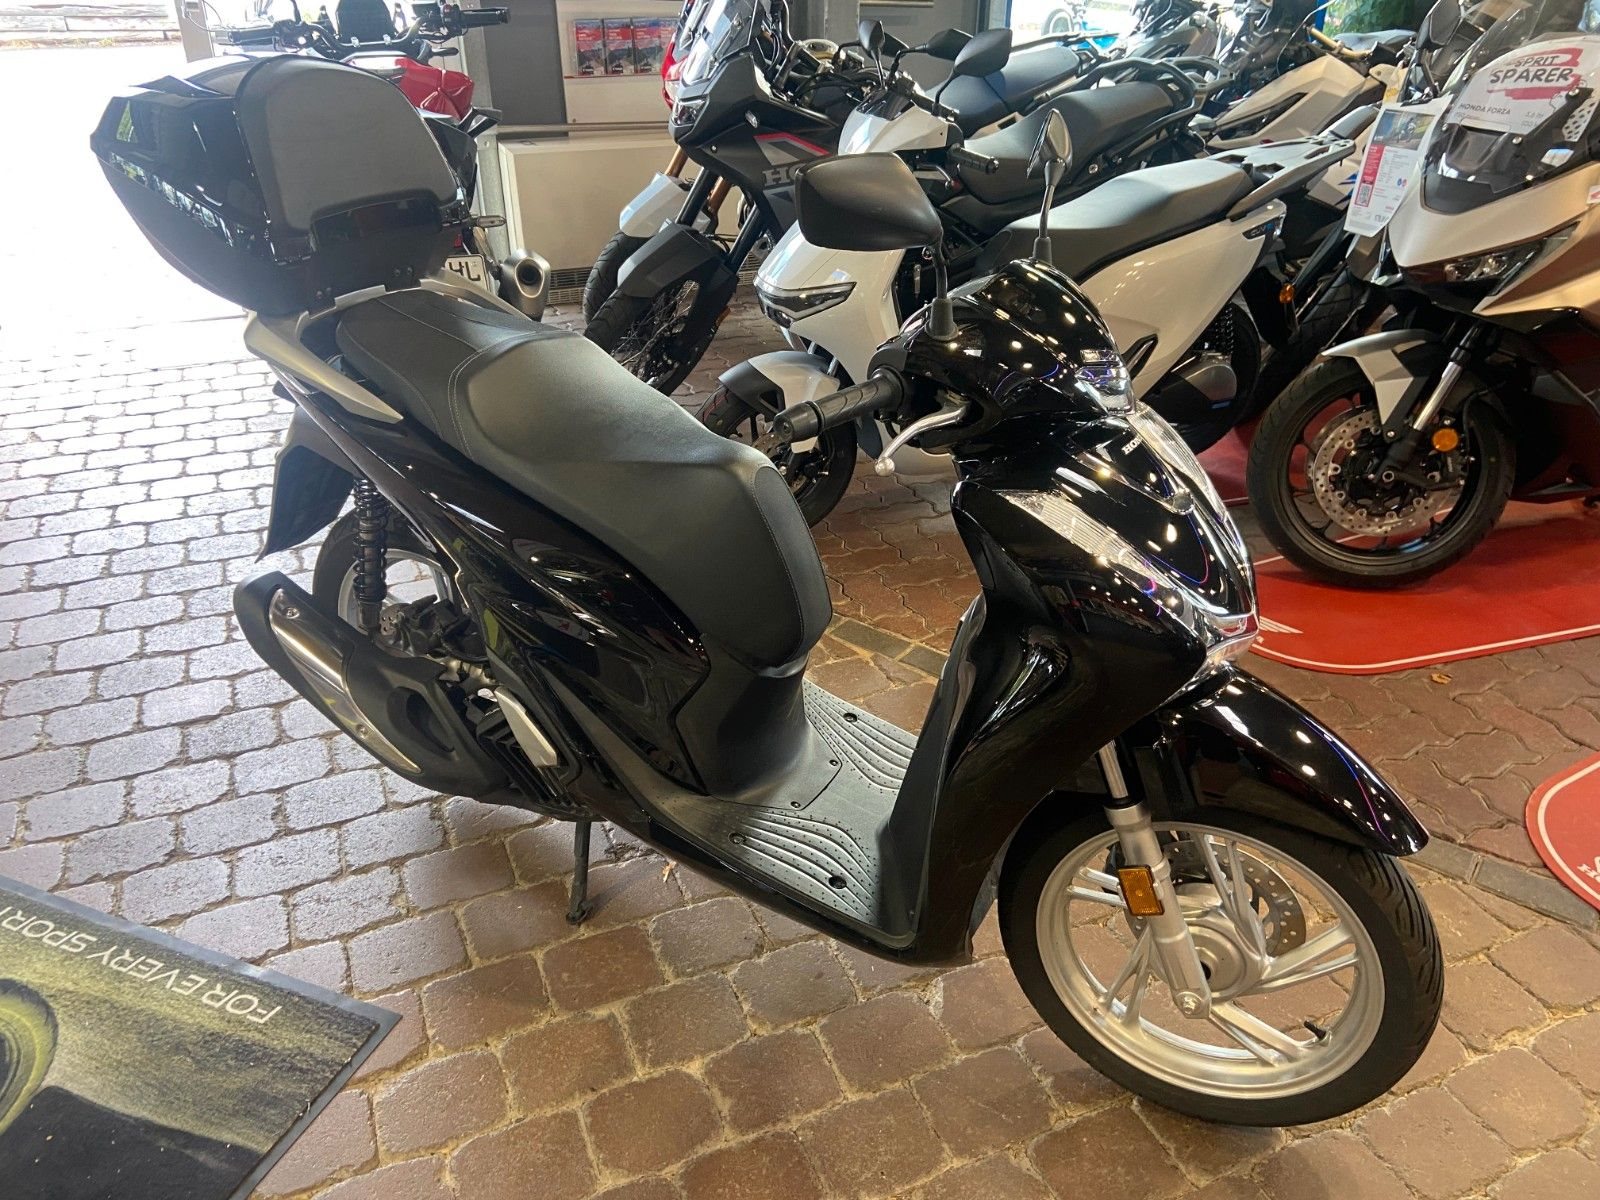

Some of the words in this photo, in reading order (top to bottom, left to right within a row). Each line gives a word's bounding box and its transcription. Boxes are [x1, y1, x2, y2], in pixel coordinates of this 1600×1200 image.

[1514, 55, 1560, 68] SPRIT
[1489, 67, 1573, 84] SPARER
[1459, 103, 1486, 113] HONDA
[1487, 106, 1511, 115] FORZA
[86, 945, 208, 996] EVERY
[201, 983, 282, 1024] FOR
